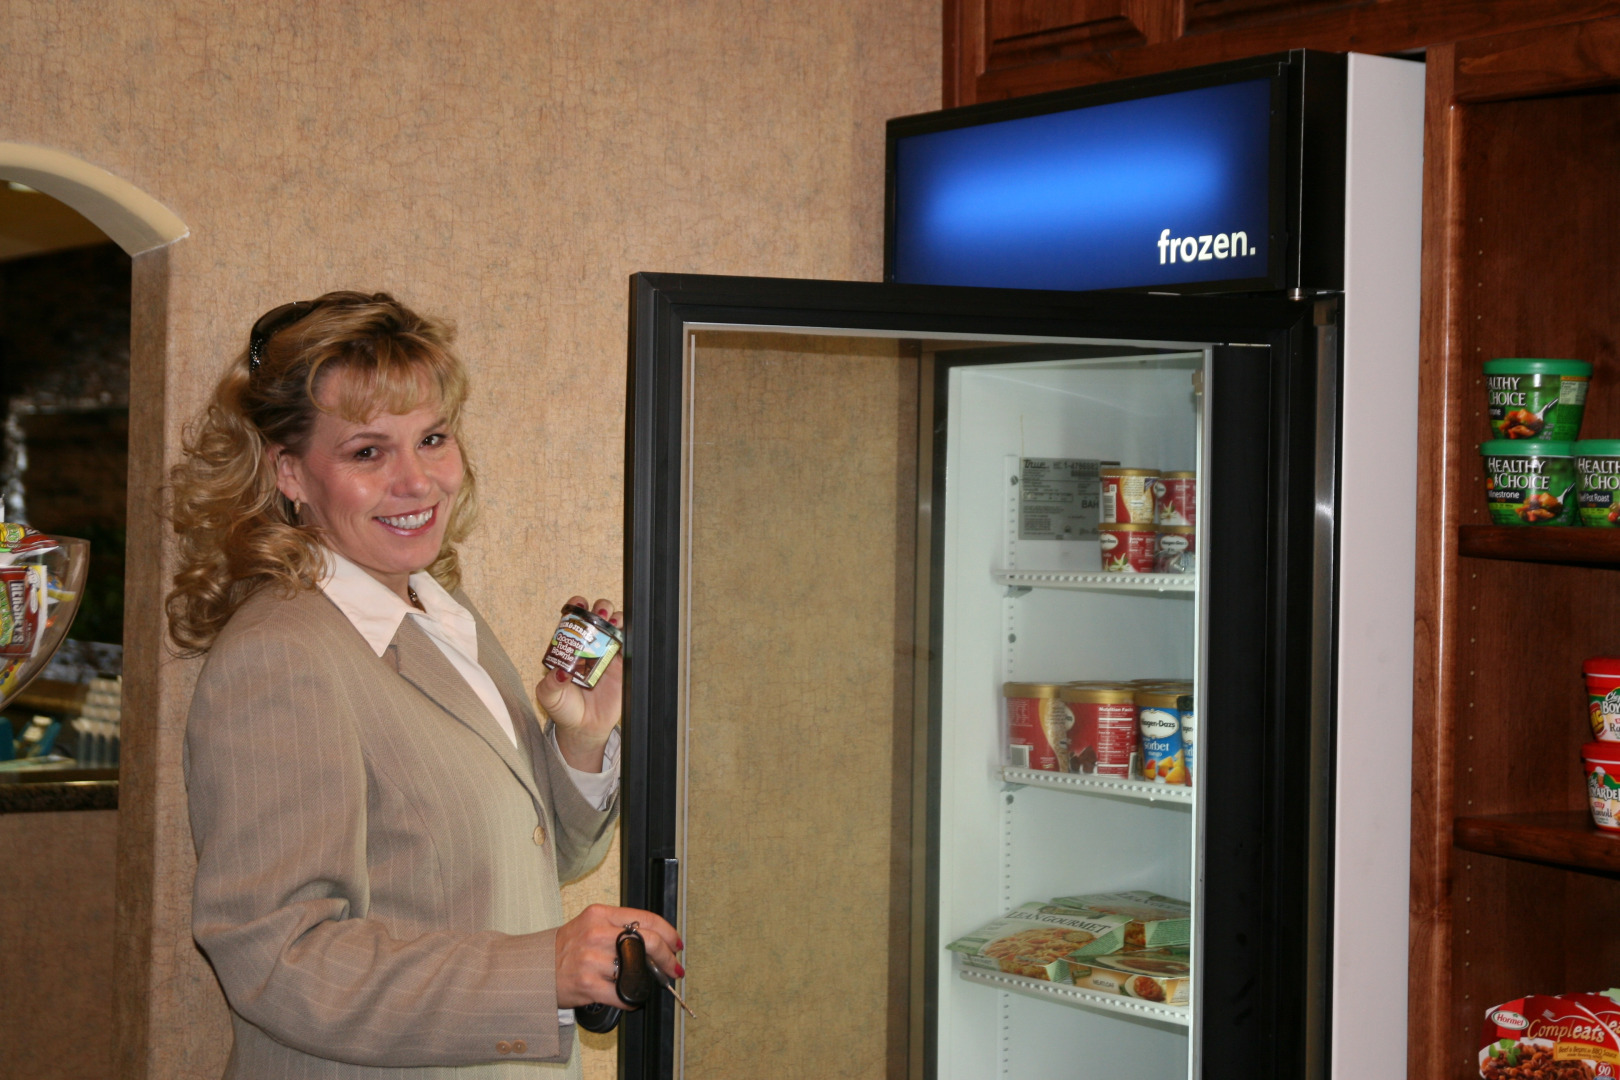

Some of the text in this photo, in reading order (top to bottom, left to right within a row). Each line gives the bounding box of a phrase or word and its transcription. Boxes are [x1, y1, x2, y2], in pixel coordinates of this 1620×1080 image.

[1157, 228, 1256, 265] frozen.
[1488, 457, 1546, 474] HEALTHY
[1498, 473, 1550, 490] CHOICE
[10, 581, 25, 645] HERSHEY'S
[1144, 740, 1170, 752] sorbet
[1006, 911, 1112, 934] LEAN GOURMET
[1496, 1014, 1524, 1027] Hormel
[1527, 1018, 1605, 1044] Compleats
[1598, 1064, 1611, 1076] 90
